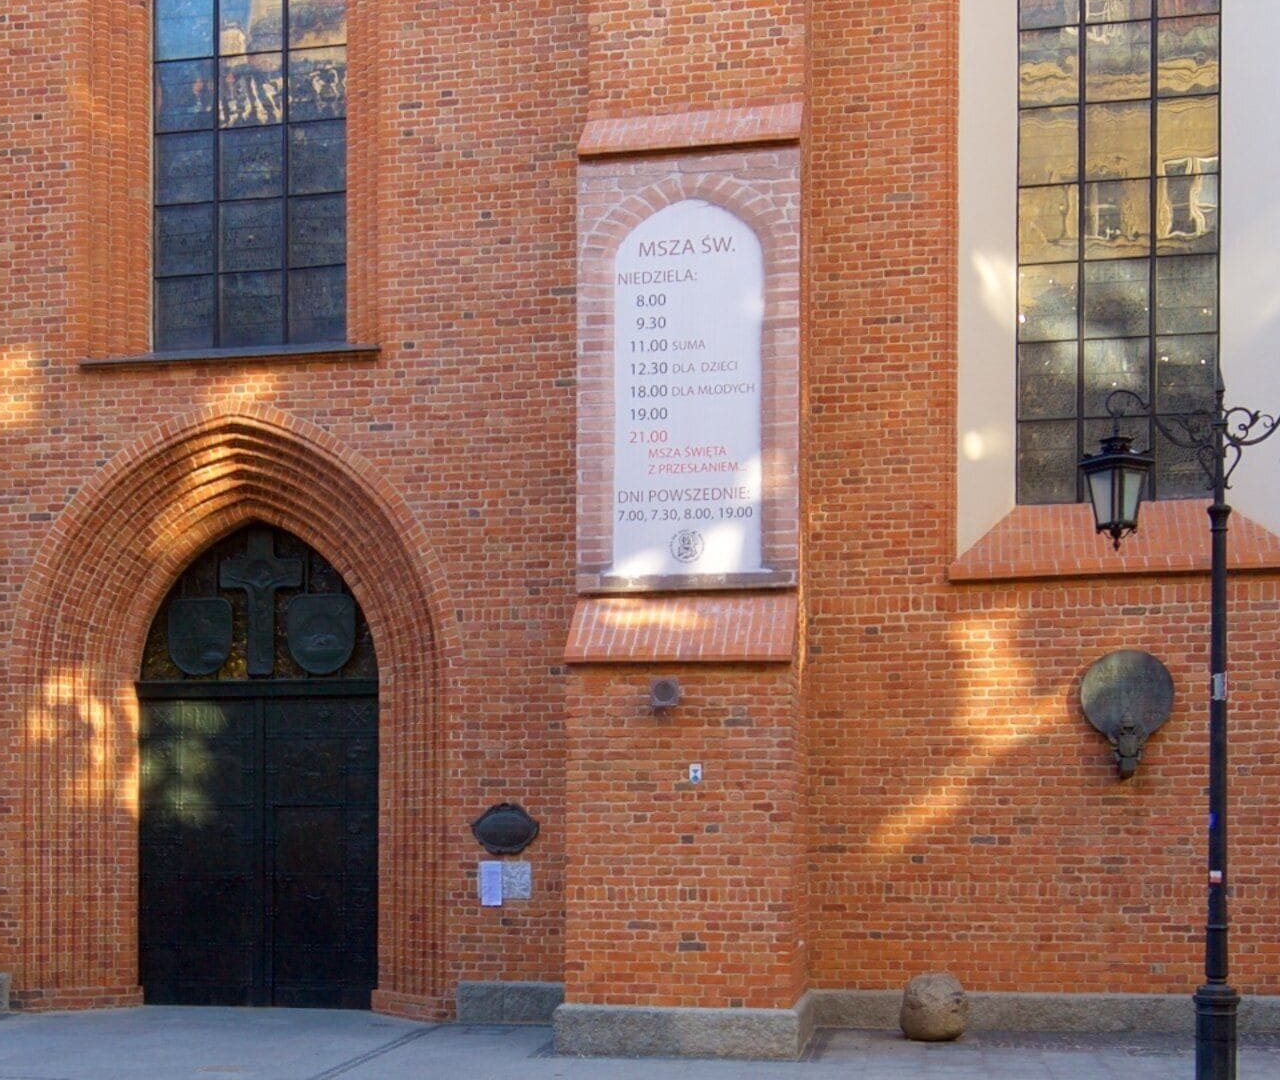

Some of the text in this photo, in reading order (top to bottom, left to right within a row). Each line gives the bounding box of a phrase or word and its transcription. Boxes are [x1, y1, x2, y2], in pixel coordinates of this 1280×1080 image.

[638, 234, 736, 257] MSZA ŚW.
[618, 269, 698, 285] NIEDZIELA:
[636, 293, 667, 307] 8.00
[636, 316, 667, 330] 9.30
[630, 339, 706, 352] 11.00 SUMA
[630, 360, 738, 375] 12.30 DLA DZIECI
[630, 383, 755, 398] 18.00 DLA MŁODYCH
[630, 407, 668, 420] 19.00
[629, 430, 668, 444] 21.00
[648, 445, 727, 458] MSZA ŚWIĘTA
[648, 464, 656, 475] Z
[618, 486, 751, 504] DNI POWSZEDNIE:
[618, 506, 753, 522] 7.00, 7.30, 8.00, 19.00
